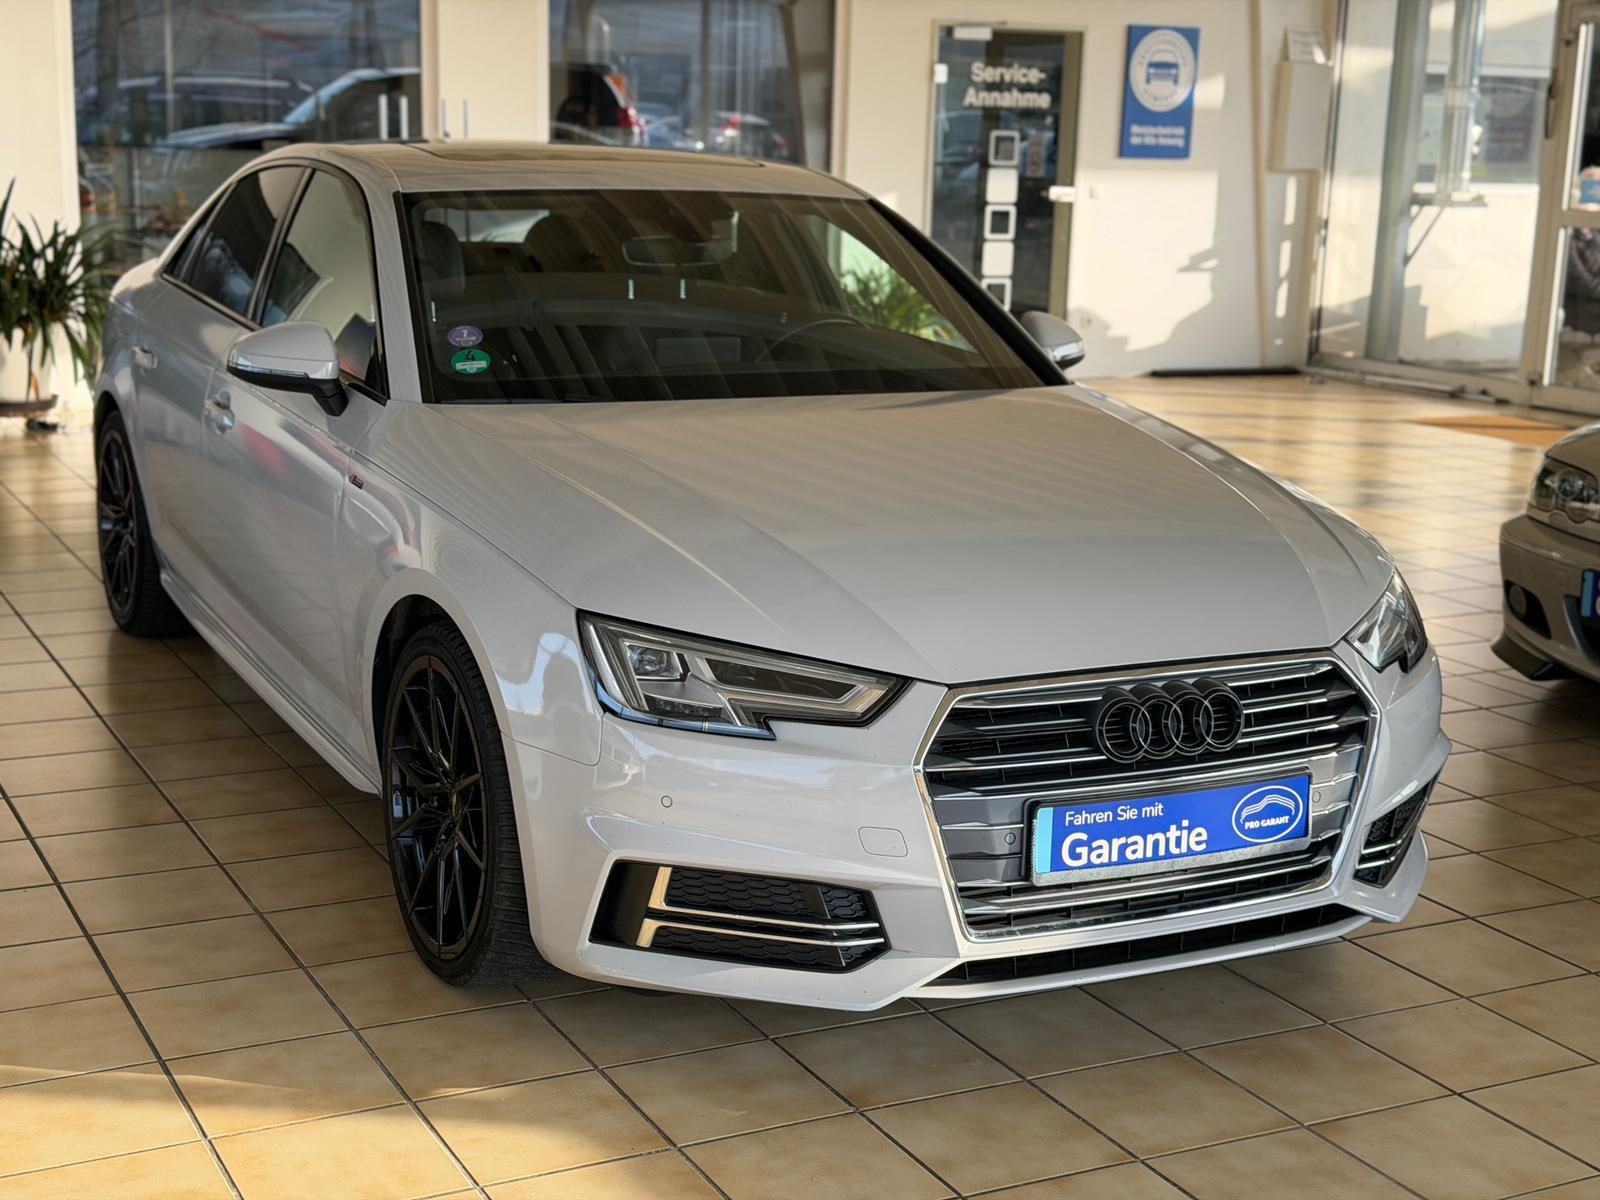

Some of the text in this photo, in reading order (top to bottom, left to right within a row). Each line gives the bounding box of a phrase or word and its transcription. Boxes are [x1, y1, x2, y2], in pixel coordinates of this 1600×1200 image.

[970, 61, 1047, 84] Service-
[963, 86, 1052, 109] Annahme
[464, 349, 476, 361] 4
[1065, 802, 1164, 827] Fahren Sie mit
[1244, 815, 1290, 830] PRO GARANT
[1061, 819, 1208, 867] Garantie
